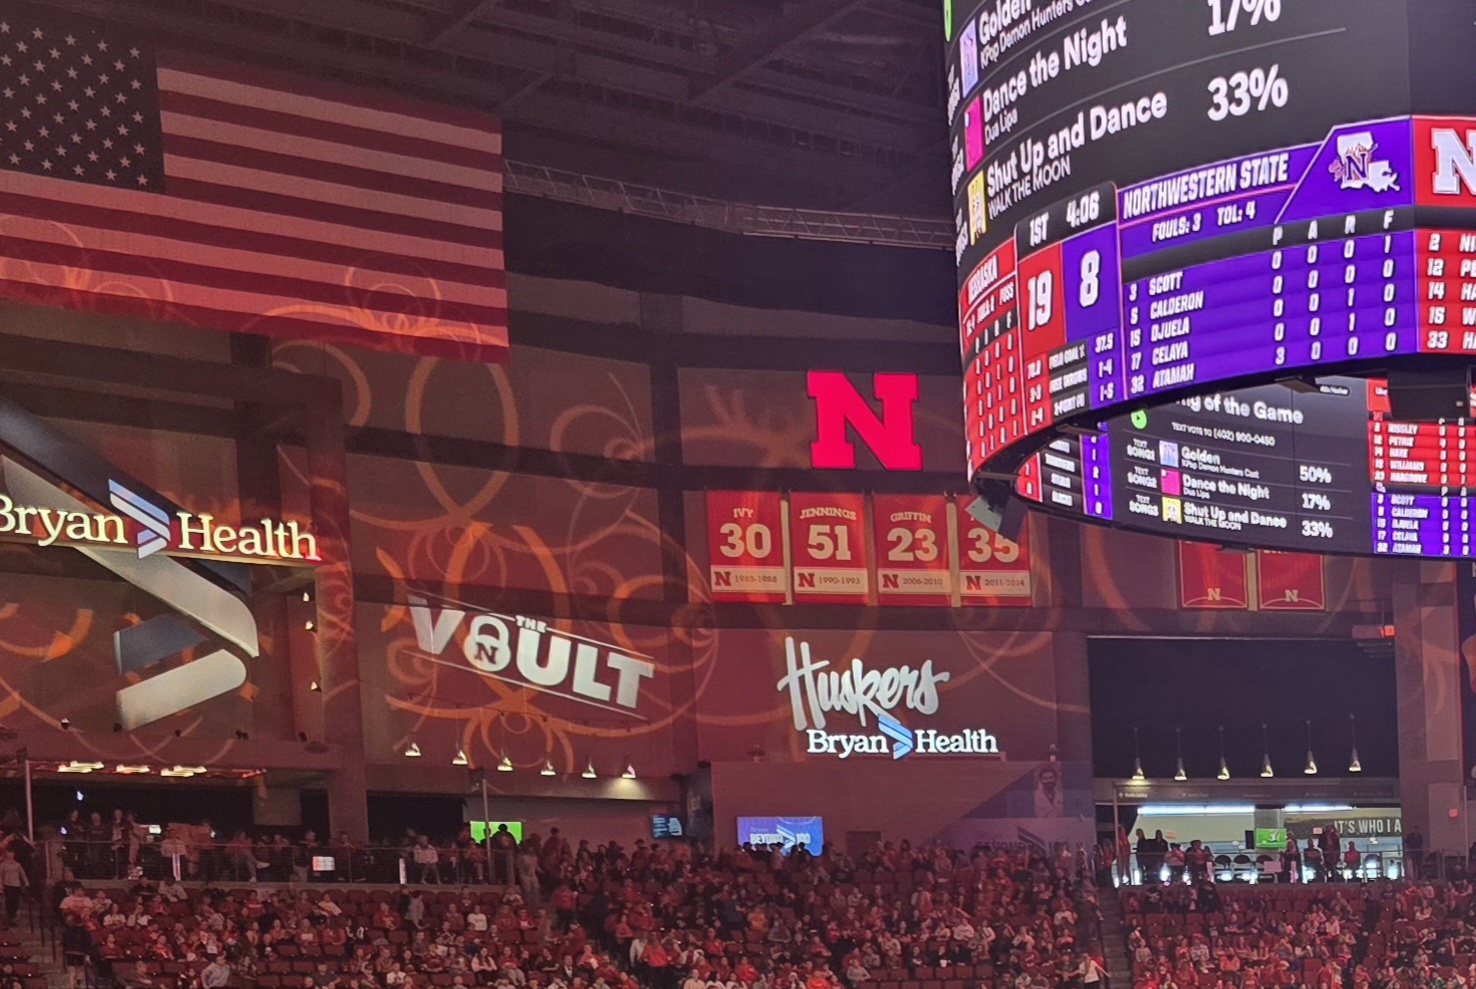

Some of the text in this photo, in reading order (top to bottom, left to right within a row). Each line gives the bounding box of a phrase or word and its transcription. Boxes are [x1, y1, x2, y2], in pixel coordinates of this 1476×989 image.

[982, 70, 1027, 122] Dance
[1029, 51, 1060, 87] the
[1063, 15, 1127, 70] Night
[1206, 64, 1289, 122] 33%
[987, 91, 1167, 197] Shut Up and Dance
[988, 156, 1071, 220] WALK THE MOON
[1123, 152, 1289, 219] NORTHWESTERN STATE
[1029, 191, 1100, 247] 1ST 4:06
[1152, 205, 1243, 243] FOULS: TOL:
[1427, 258, 1444, 277] 12
[1028, 270, 1053, 331] 19
[1080, 250, 1100, 308] 8
[1148, 271, 1183, 296] SCOTT
[1427, 282, 1445, 300] 14
[1150, 290, 1204, 320] CALDERON
[1428, 306, 1445, 325] 15
[1152, 340, 1189, 366] CELAYA
[1427, 331, 1449, 349] 33
[807, 370, 923, 471] N
[1204, 394, 1304, 424] of the Game
[1181, 446, 1221, 465] Golden
[1183, 474, 1216, 493] Dance
[1238, 482, 1270, 500] Night
[1299, 465, 1332, 484] 50%
[733, 507, 754, 519] IVY
[799, 507, 857, 521] JENNINGS
[1301, 493, 1331, 511] 17%
[0, 494, 322, 561] Bryan Health
[890, 512, 932, 524] GRIFFIN
[1184, 502, 1210, 518] Shut
[1250, 510, 1287, 529] Dance
[719, 522, 772, 559] 30
[806, 524, 852, 561] 51
[1301, 520, 1333, 539] 33%
[886, 527, 939, 562] 23
[967, 527, 1020, 563] 35
[714, 571, 732, 587] N
[798, 572, 815, 588] N
[882, 573, 899, 589] N
[966, 575, 982, 591] N
[516, 614, 546, 633] THE
[777, 637, 950, 731] Huskers
[807, 729, 999, 759] Bryan Health
[1358, 820, 1383, 834] WHO
